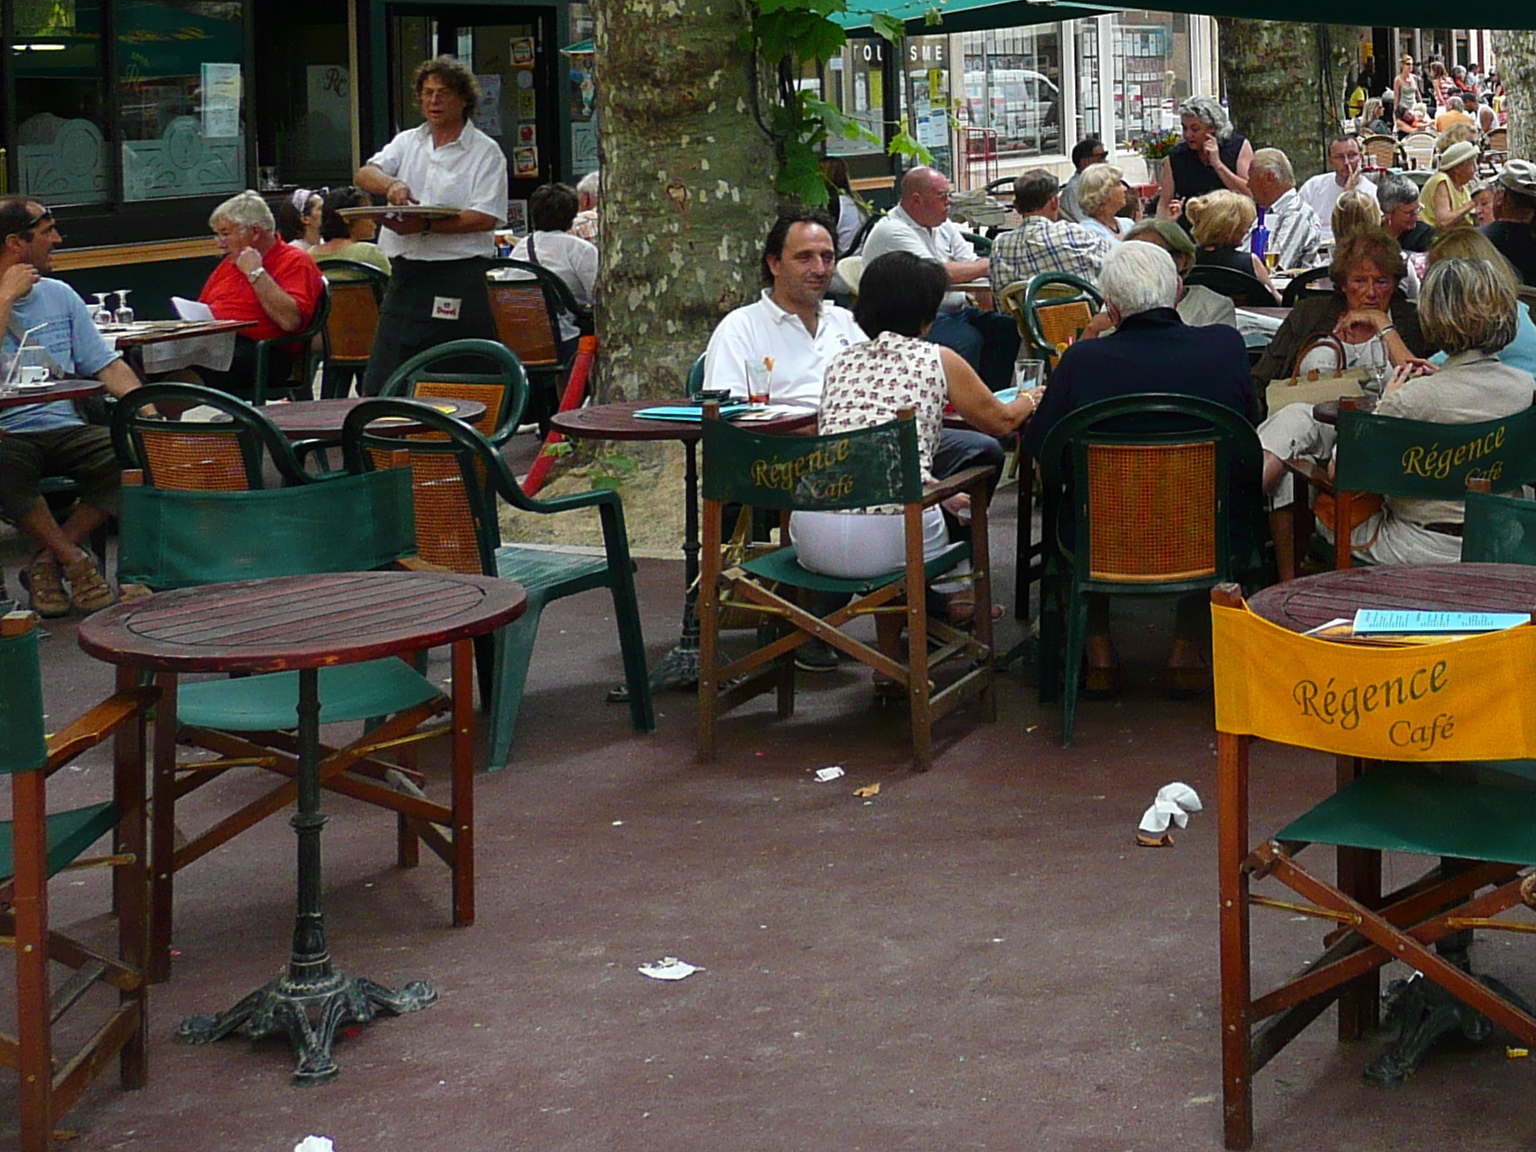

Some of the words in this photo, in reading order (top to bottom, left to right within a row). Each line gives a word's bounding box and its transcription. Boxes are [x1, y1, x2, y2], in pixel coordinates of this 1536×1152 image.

[751, 438, 850, 490] Régence
[1402, 426, 1506, 480] Régence
[811, 474, 854, 502] Café
[1292, 660, 1449, 731] Régence
[1388, 713, 1455, 752] Café
